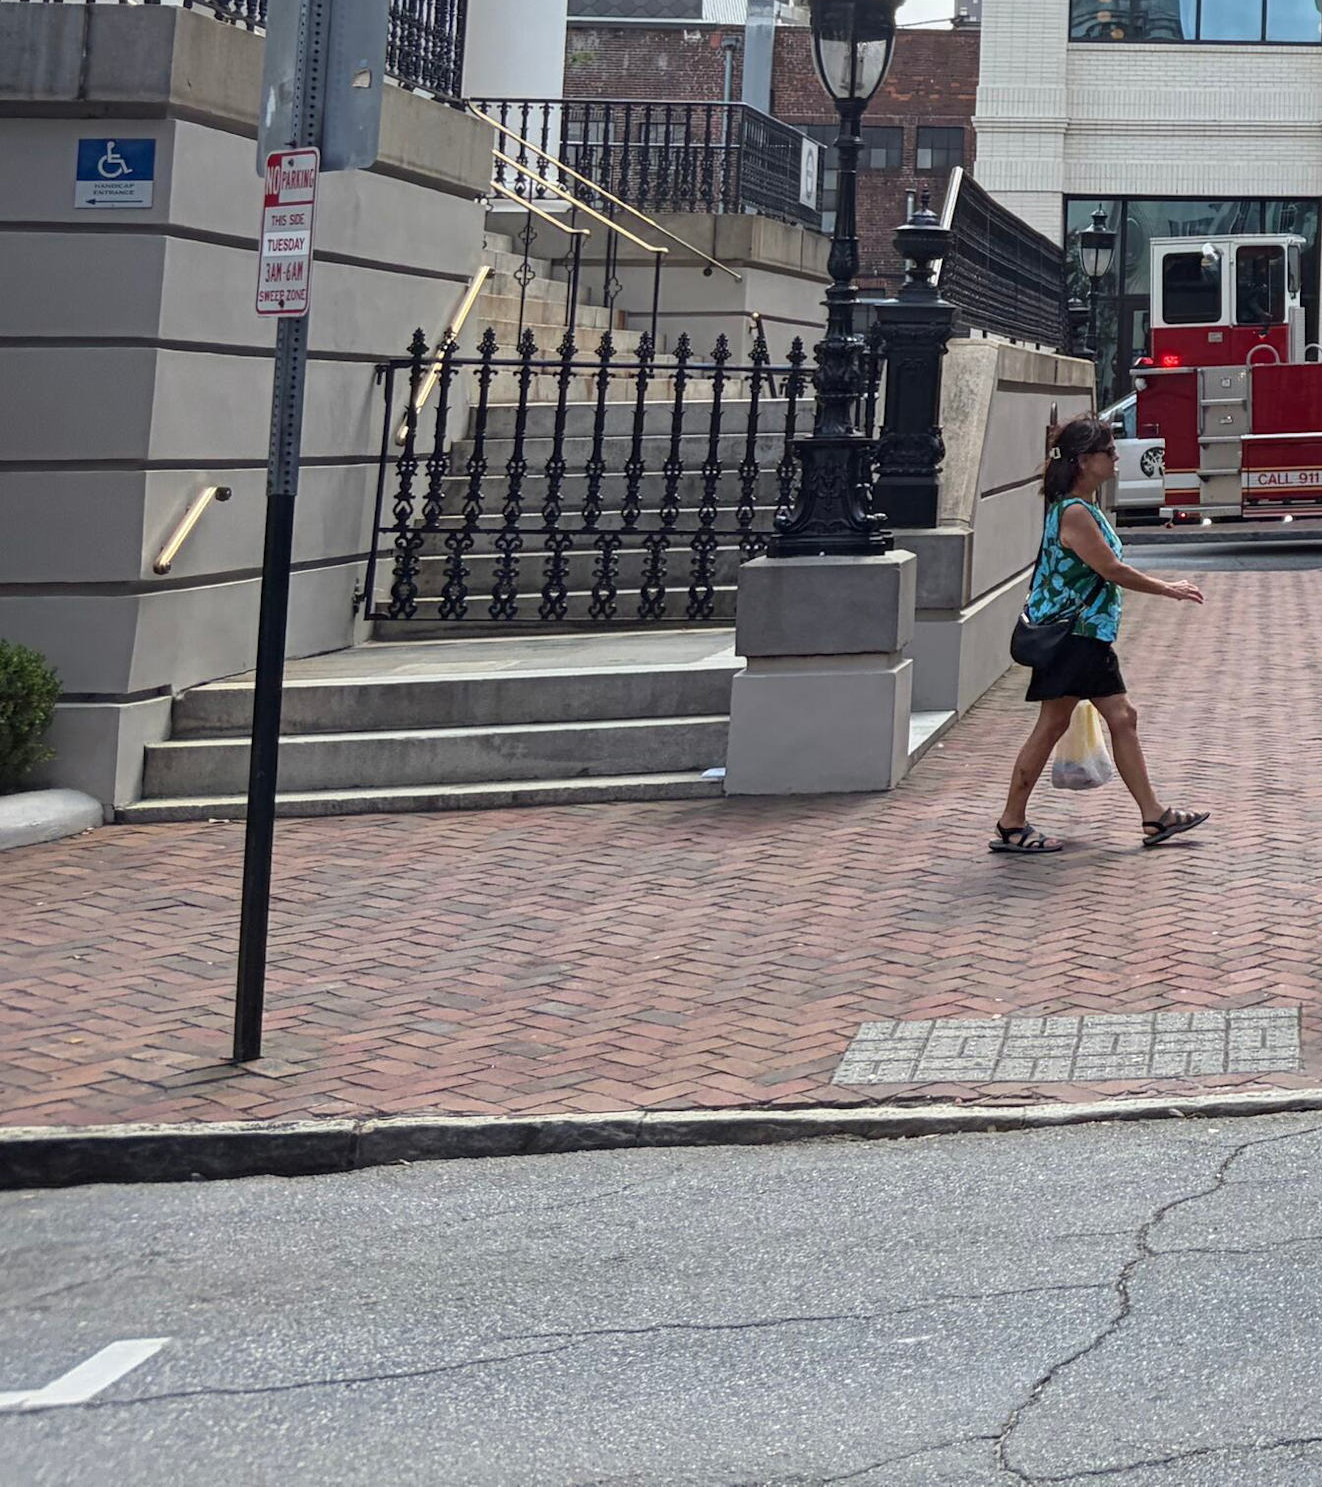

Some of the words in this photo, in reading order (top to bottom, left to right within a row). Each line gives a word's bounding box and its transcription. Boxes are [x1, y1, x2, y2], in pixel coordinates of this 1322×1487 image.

[265, 165, 280, 195] NO
[281, 169, 315, 190] PARKING
[271, 215, 287, 226] THIS
[289, 213, 305, 225] SIDE
[267, 237, 306, 252] TUESDAY
[259, 290, 285, 302] SWEEP
[286, 288, 306, 301] ZONE
[1258, 473, 1293, 485] CALL
[1299, 472, 1319, 484] 911
